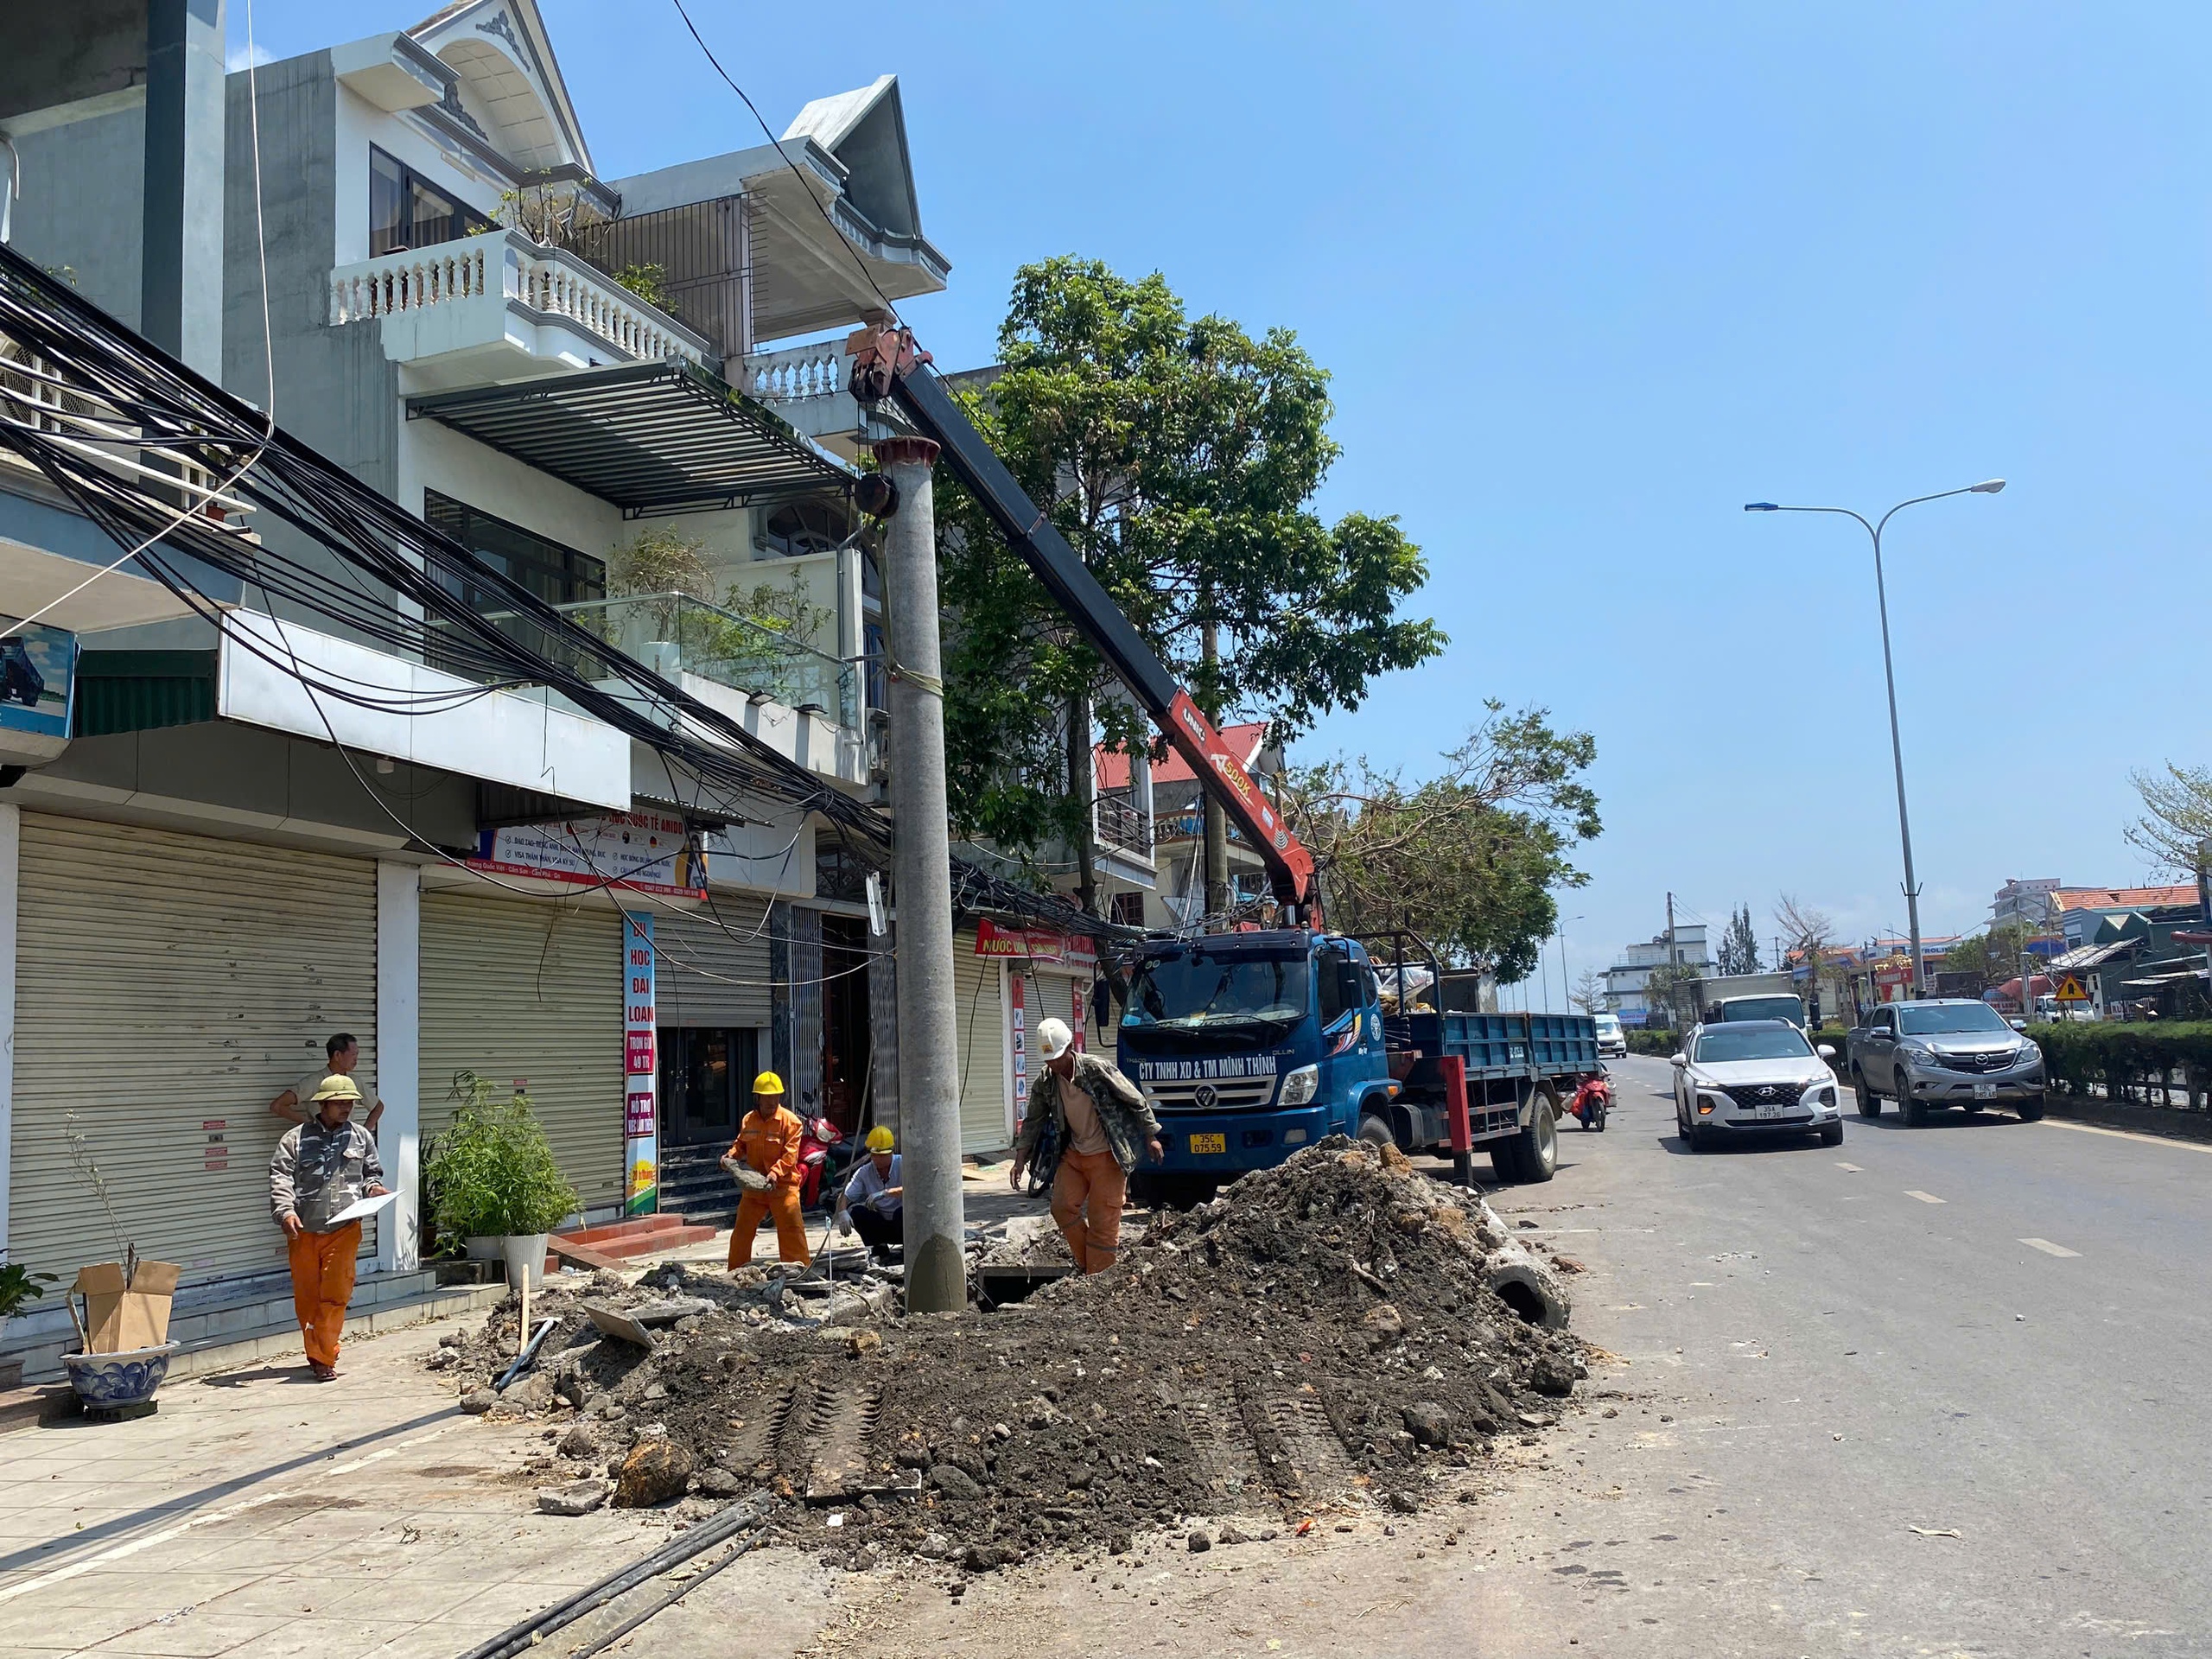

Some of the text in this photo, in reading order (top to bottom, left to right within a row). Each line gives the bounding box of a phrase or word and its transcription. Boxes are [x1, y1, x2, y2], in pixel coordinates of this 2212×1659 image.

[515, 851, 524, 860] VISA
[982, 938, 1012, 953] NƯỚC
[630, 949, 650, 969] HỌC
[632, 975, 649, 994] ĐÀI
[628, 1006, 654, 1022] LOAN
[642, 1055, 650, 1069] TR
[1139, 1062, 1154, 1080] CTY
[1155, 1061, 1178, 1080] TNHH
[1179, 1061, 1192, 1079] XD
[1194, 1060, 1201, 1078] &
[1203, 1059, 1217, 1078] TM
[1200, 1135, 1215, 1143] 35C
